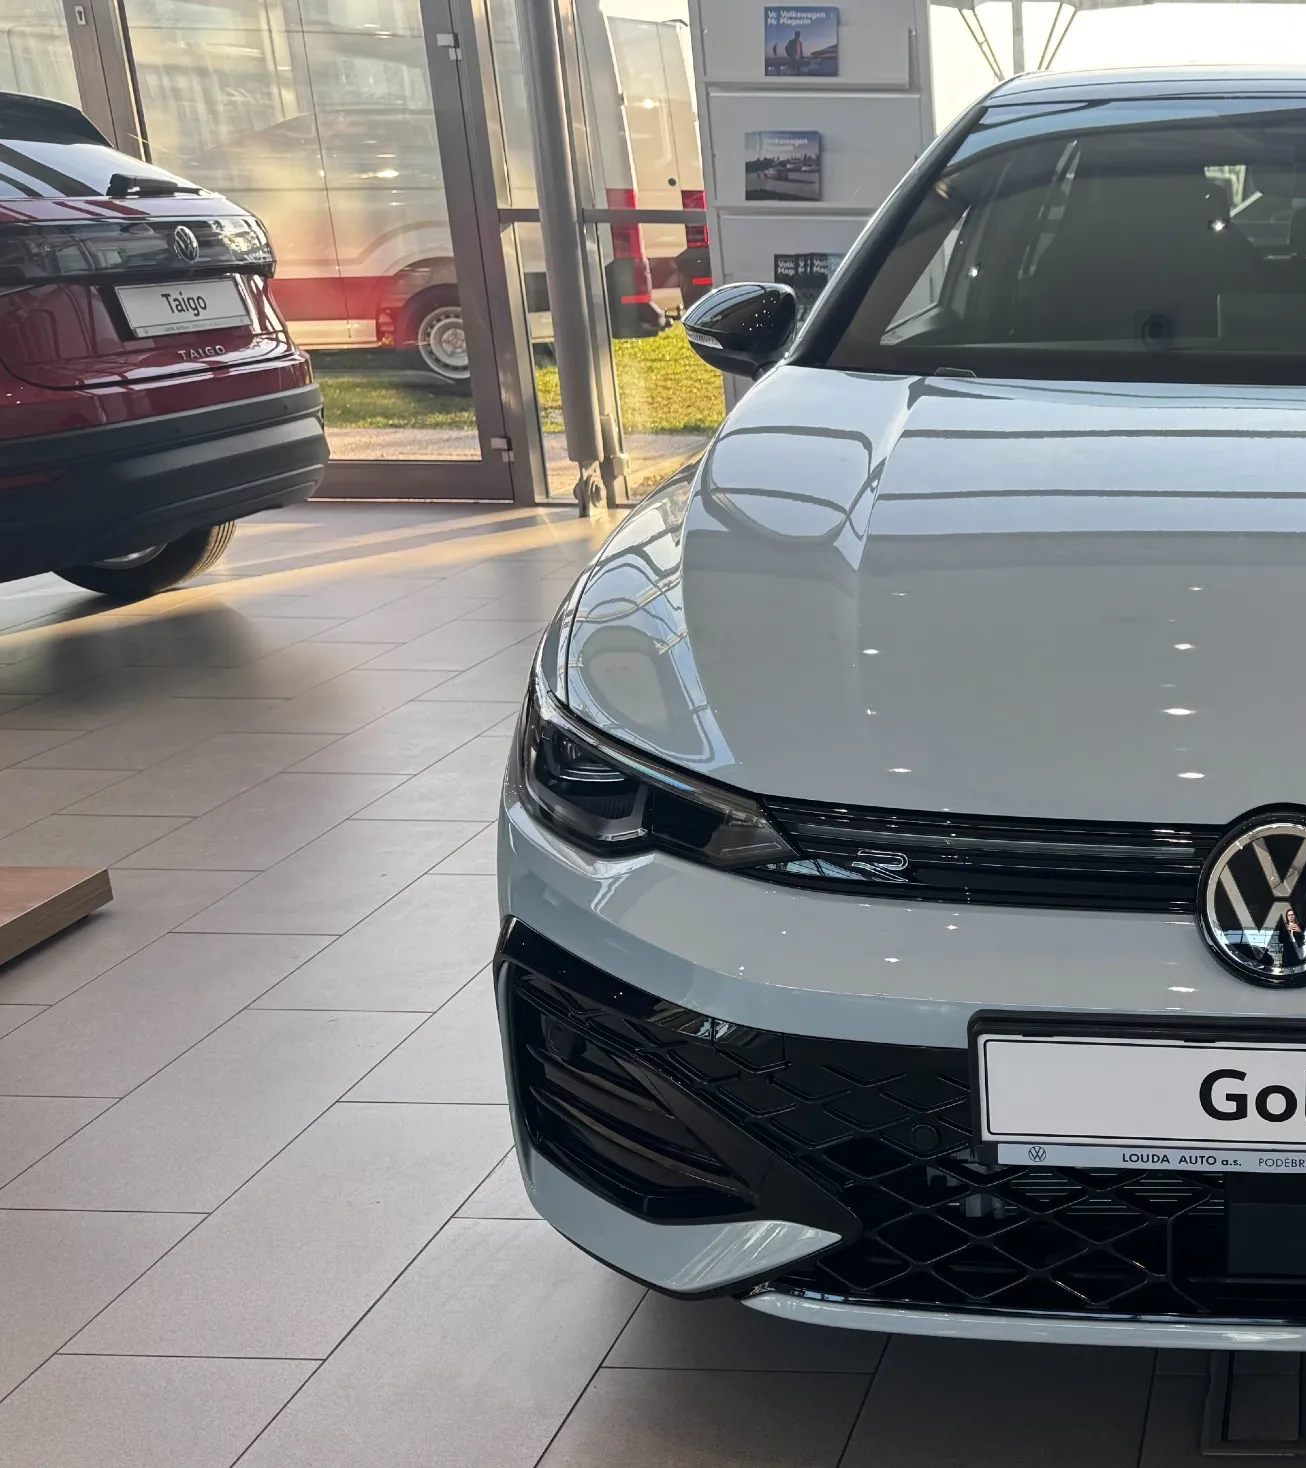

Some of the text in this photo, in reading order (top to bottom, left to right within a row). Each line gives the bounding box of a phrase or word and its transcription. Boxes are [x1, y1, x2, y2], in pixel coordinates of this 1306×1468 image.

[161, 291, 207, 317] Taigo
[178, 345, 226, 361] TAIGO
[1122, 1153, 1171, 1165] LOUDA
[1178, 1155, 1218, 1166] AUTO
[1221, 1159, 1243, 1167] a.s.
